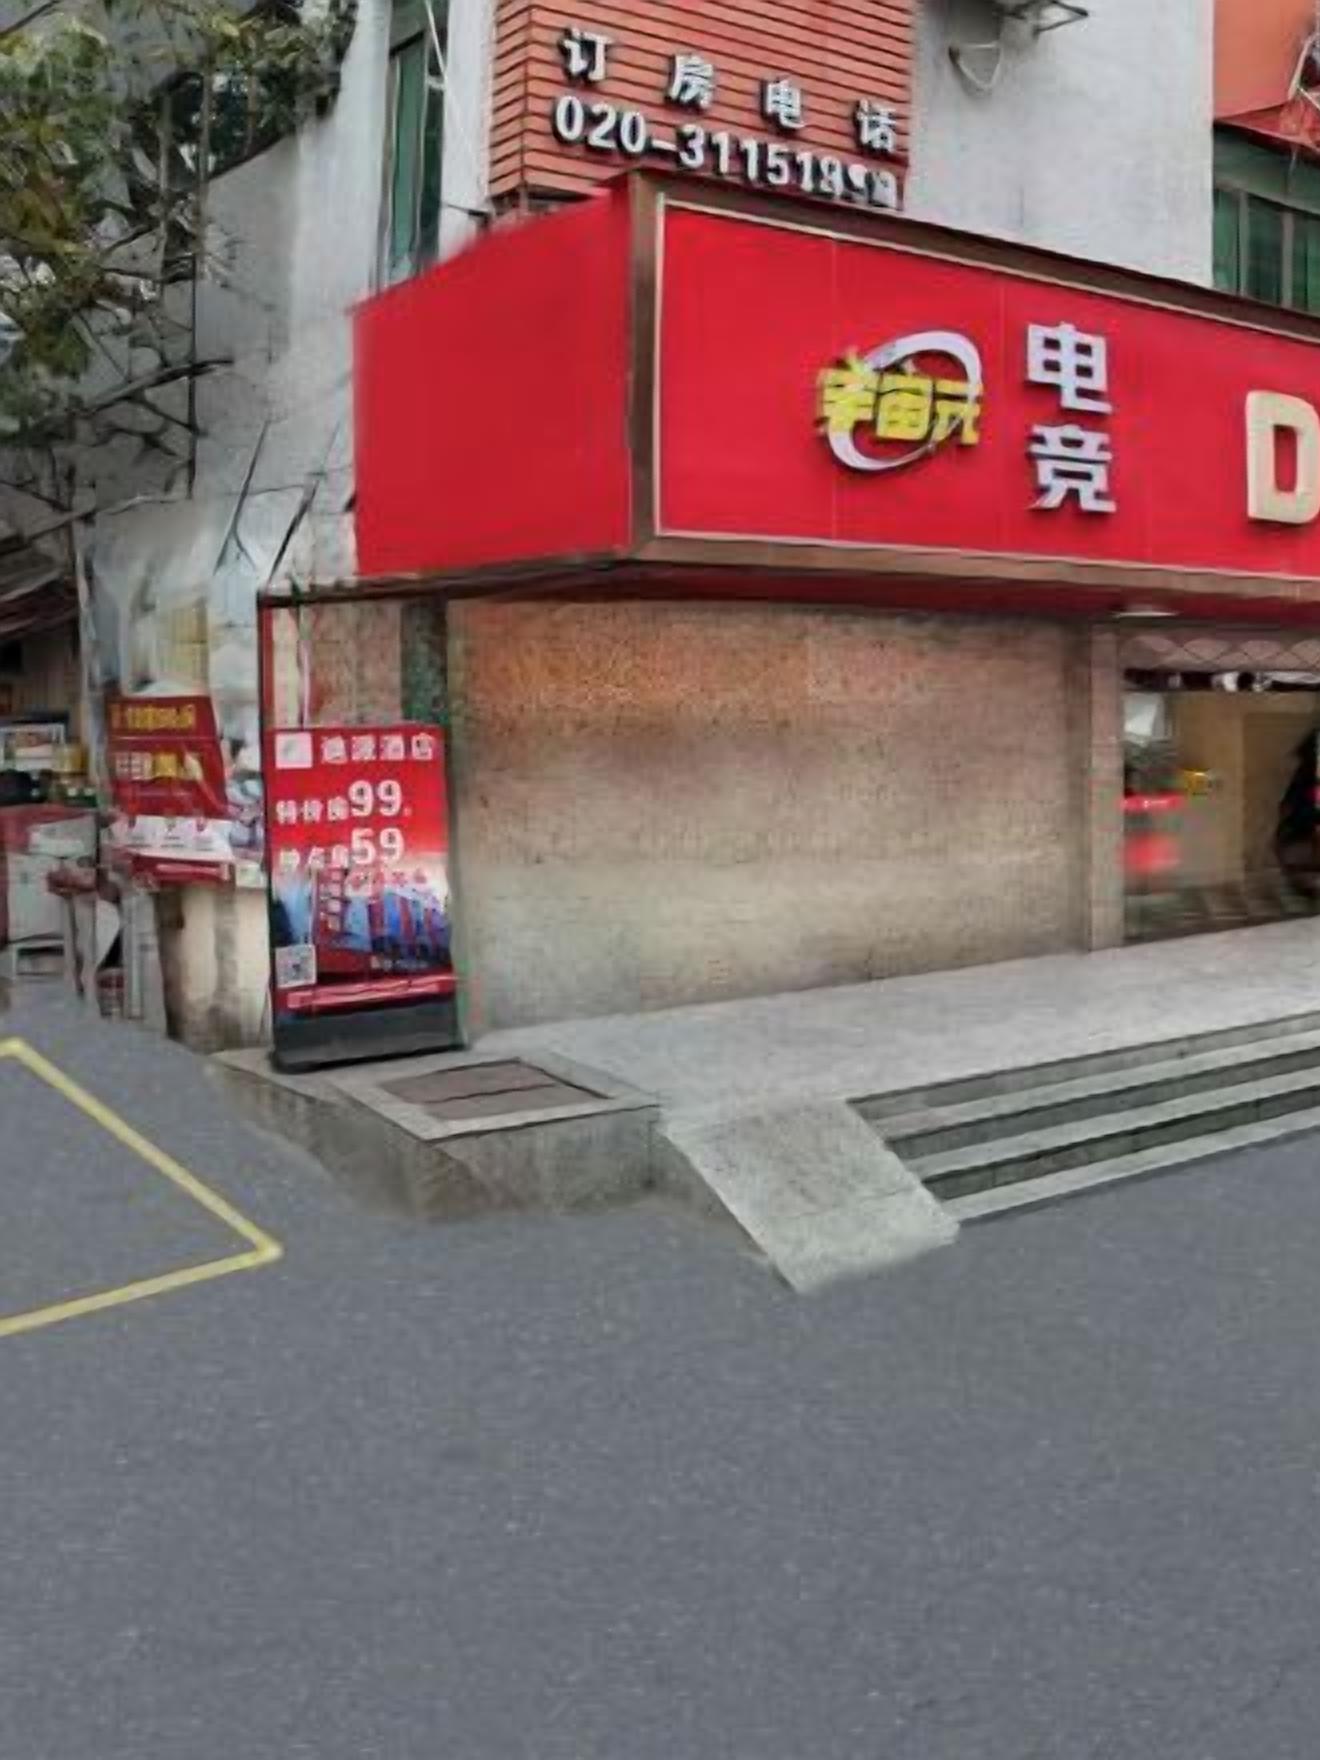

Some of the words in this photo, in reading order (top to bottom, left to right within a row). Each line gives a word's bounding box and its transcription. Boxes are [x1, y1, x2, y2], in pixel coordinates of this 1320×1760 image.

[561, 27, 898, 153] 订房电话
[1026, 321, 1117, 513] 电竞
